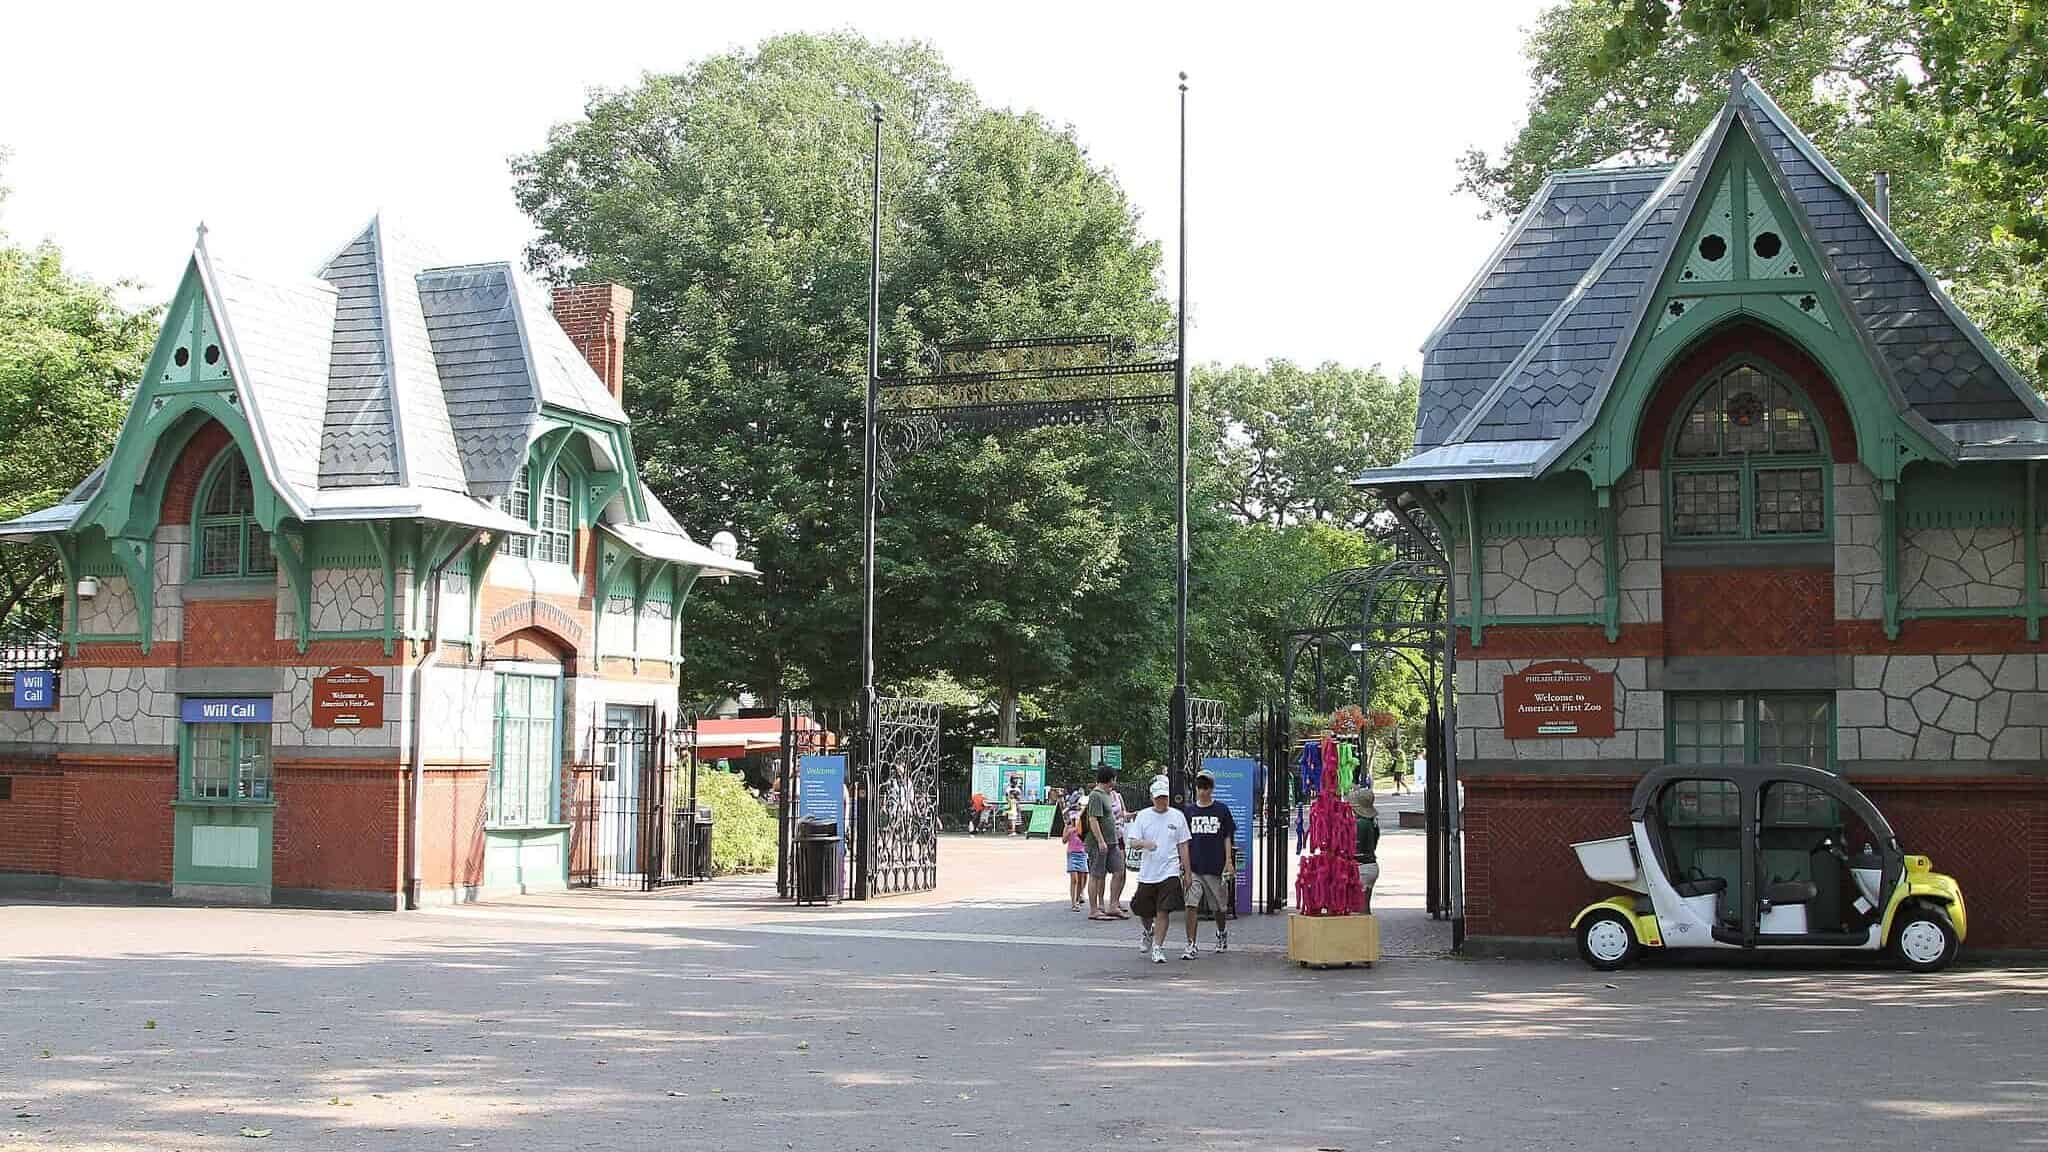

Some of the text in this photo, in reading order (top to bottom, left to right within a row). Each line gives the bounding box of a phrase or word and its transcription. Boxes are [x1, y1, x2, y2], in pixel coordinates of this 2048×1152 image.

[23, 676, 43, 689] Will
[24, 689, 43, 701] Call
[1534, 692, 1585, 702] Welcome to
[203, 704, 255, 717] Will Call
[1518, 702, 1602, 712] America's First Zoo
